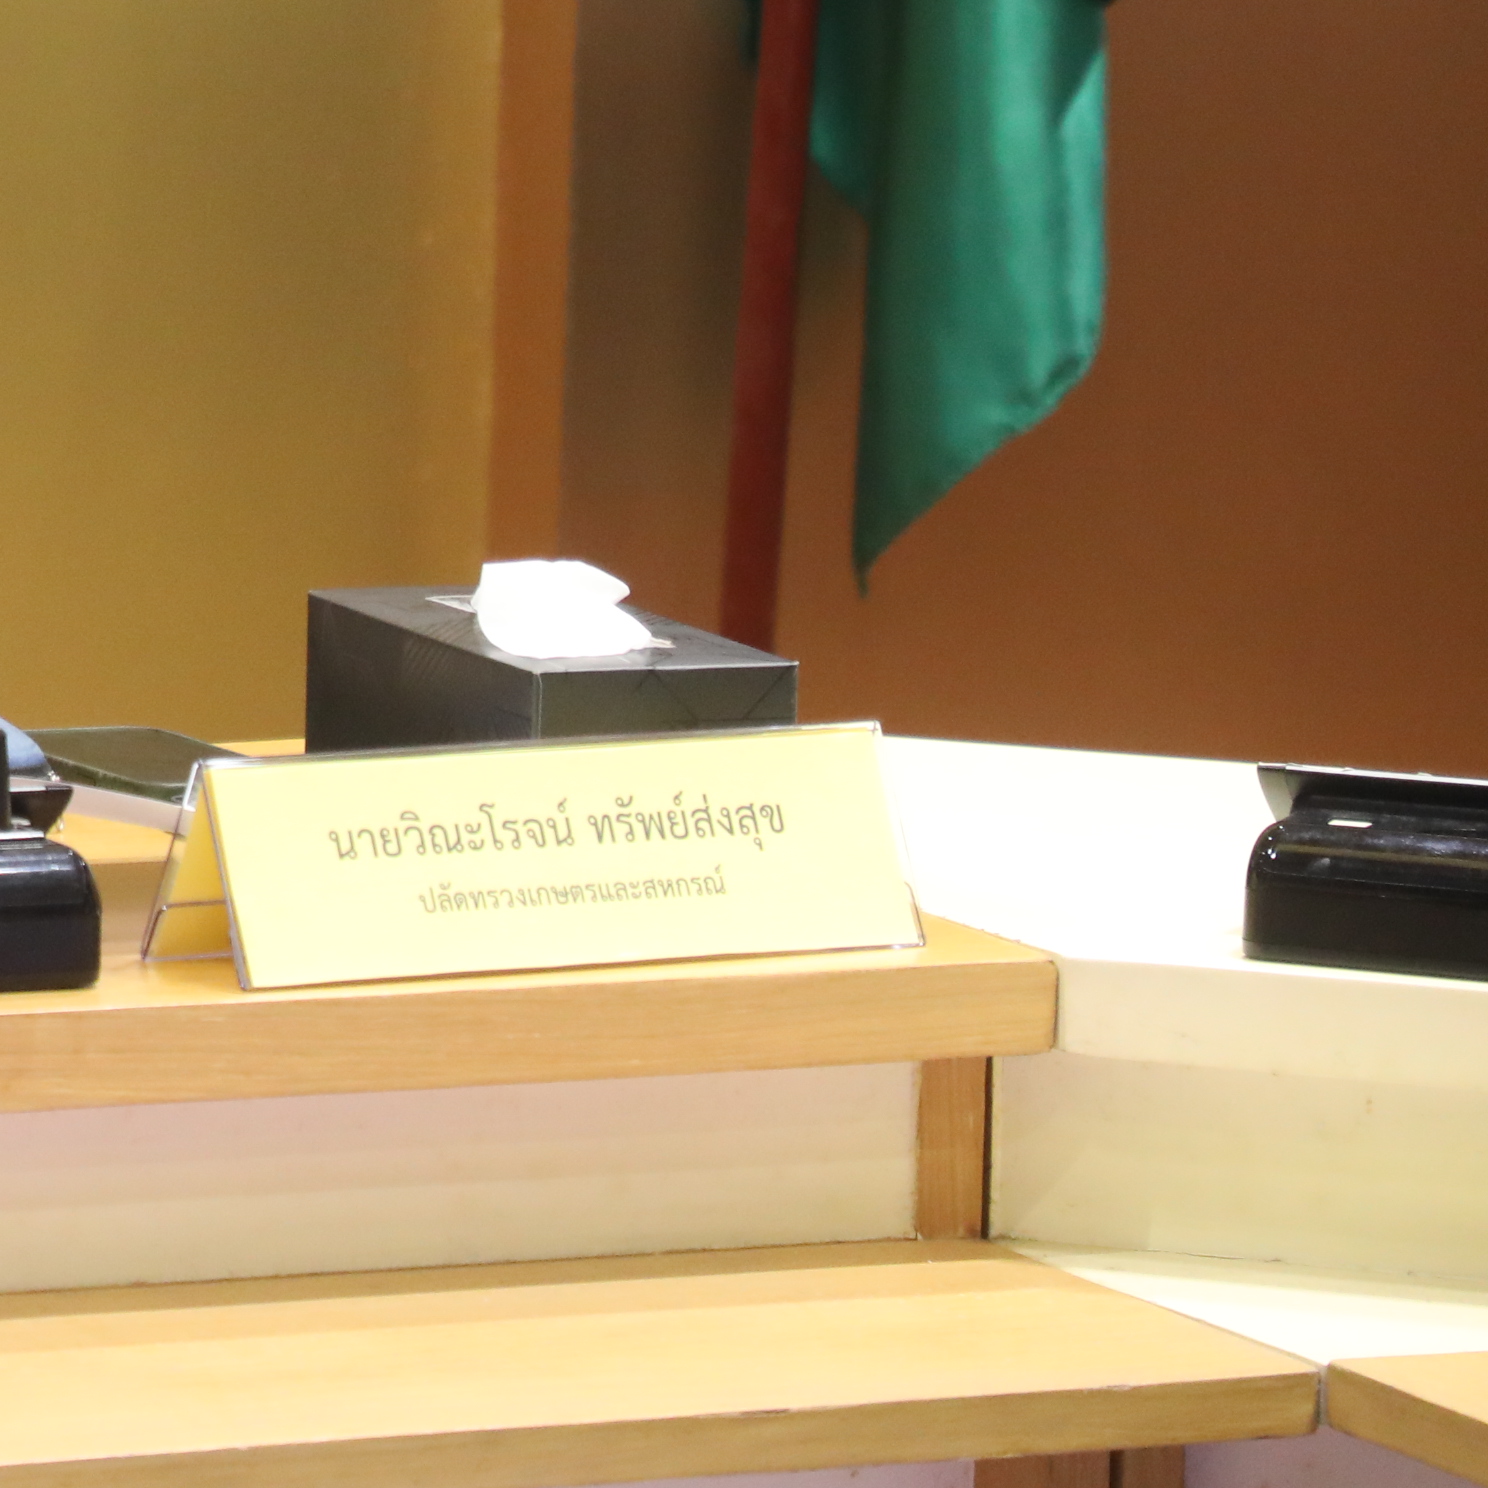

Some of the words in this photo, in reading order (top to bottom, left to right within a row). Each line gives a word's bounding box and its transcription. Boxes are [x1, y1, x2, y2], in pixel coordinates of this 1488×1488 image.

[327, 797, 576, 861] นายวิณะโรจน์
[586, 790, 786, 852] ทรัพย์ส่งสุข
[418, 863, 728, 914] ปลัดทรวงเกษตรและสหกรณ์
